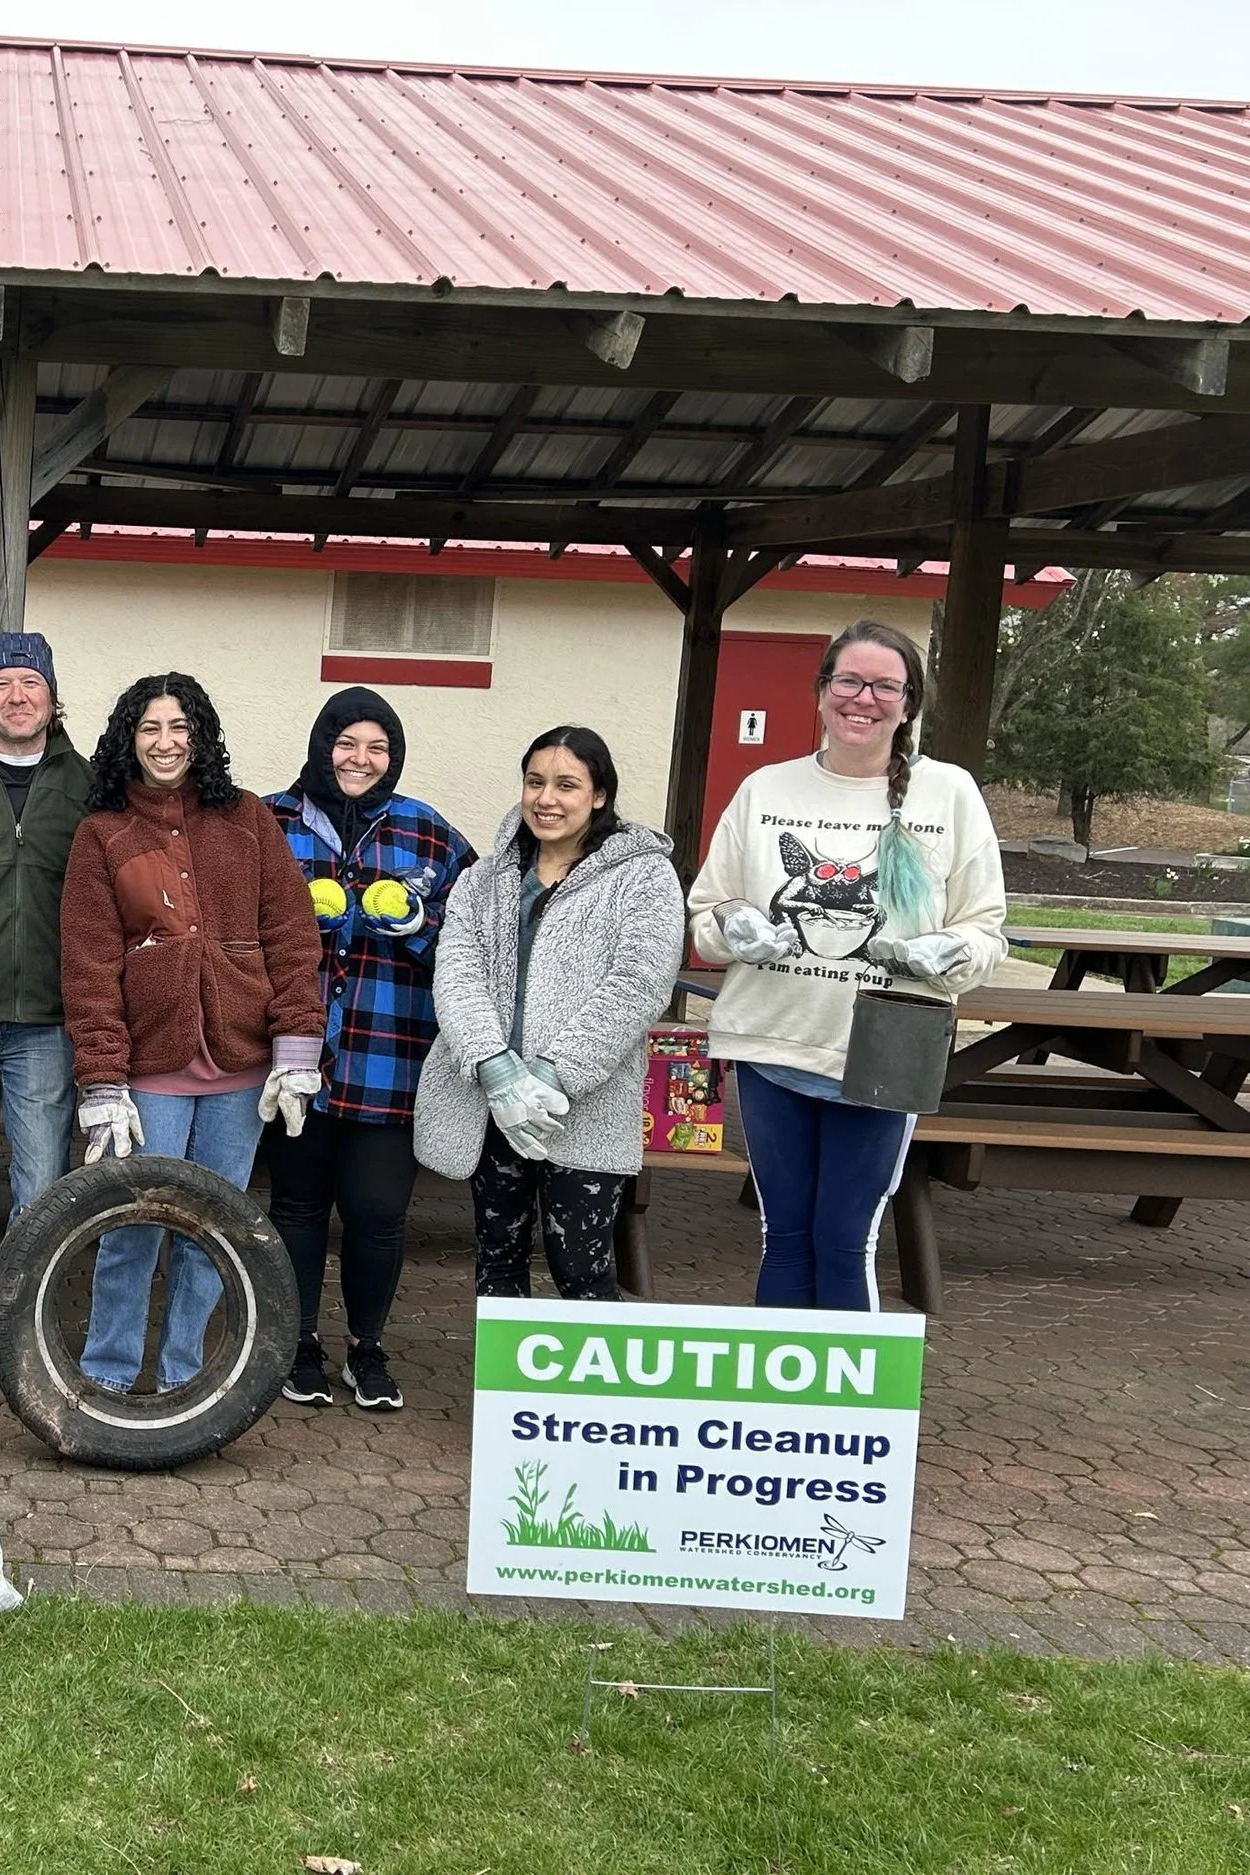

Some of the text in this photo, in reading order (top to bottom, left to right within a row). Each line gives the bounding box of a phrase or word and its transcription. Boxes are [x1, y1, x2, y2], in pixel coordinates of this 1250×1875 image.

[760, 814, 813, 828] Please
[817, 819, 862, 831] leave
[906, 821, 945, 835] lone
[768, 961, 790, 973] am
[794, 966, 850, 983] eating
[854, 971, 894, 989] soup
[516, 1333, 877, 1395] CAUTION
[512, 1410, 891, 1465] Stream Cleanup
[618, 1461, 887, 1506] in Progress
[679, 1547, 823, 1560] WATERSHED CONSERVANCY
[680, 1530, 835, 1554] PERKIOMEN
[495, 1565, 876, 1605] www.perkiomenwatershed.org
